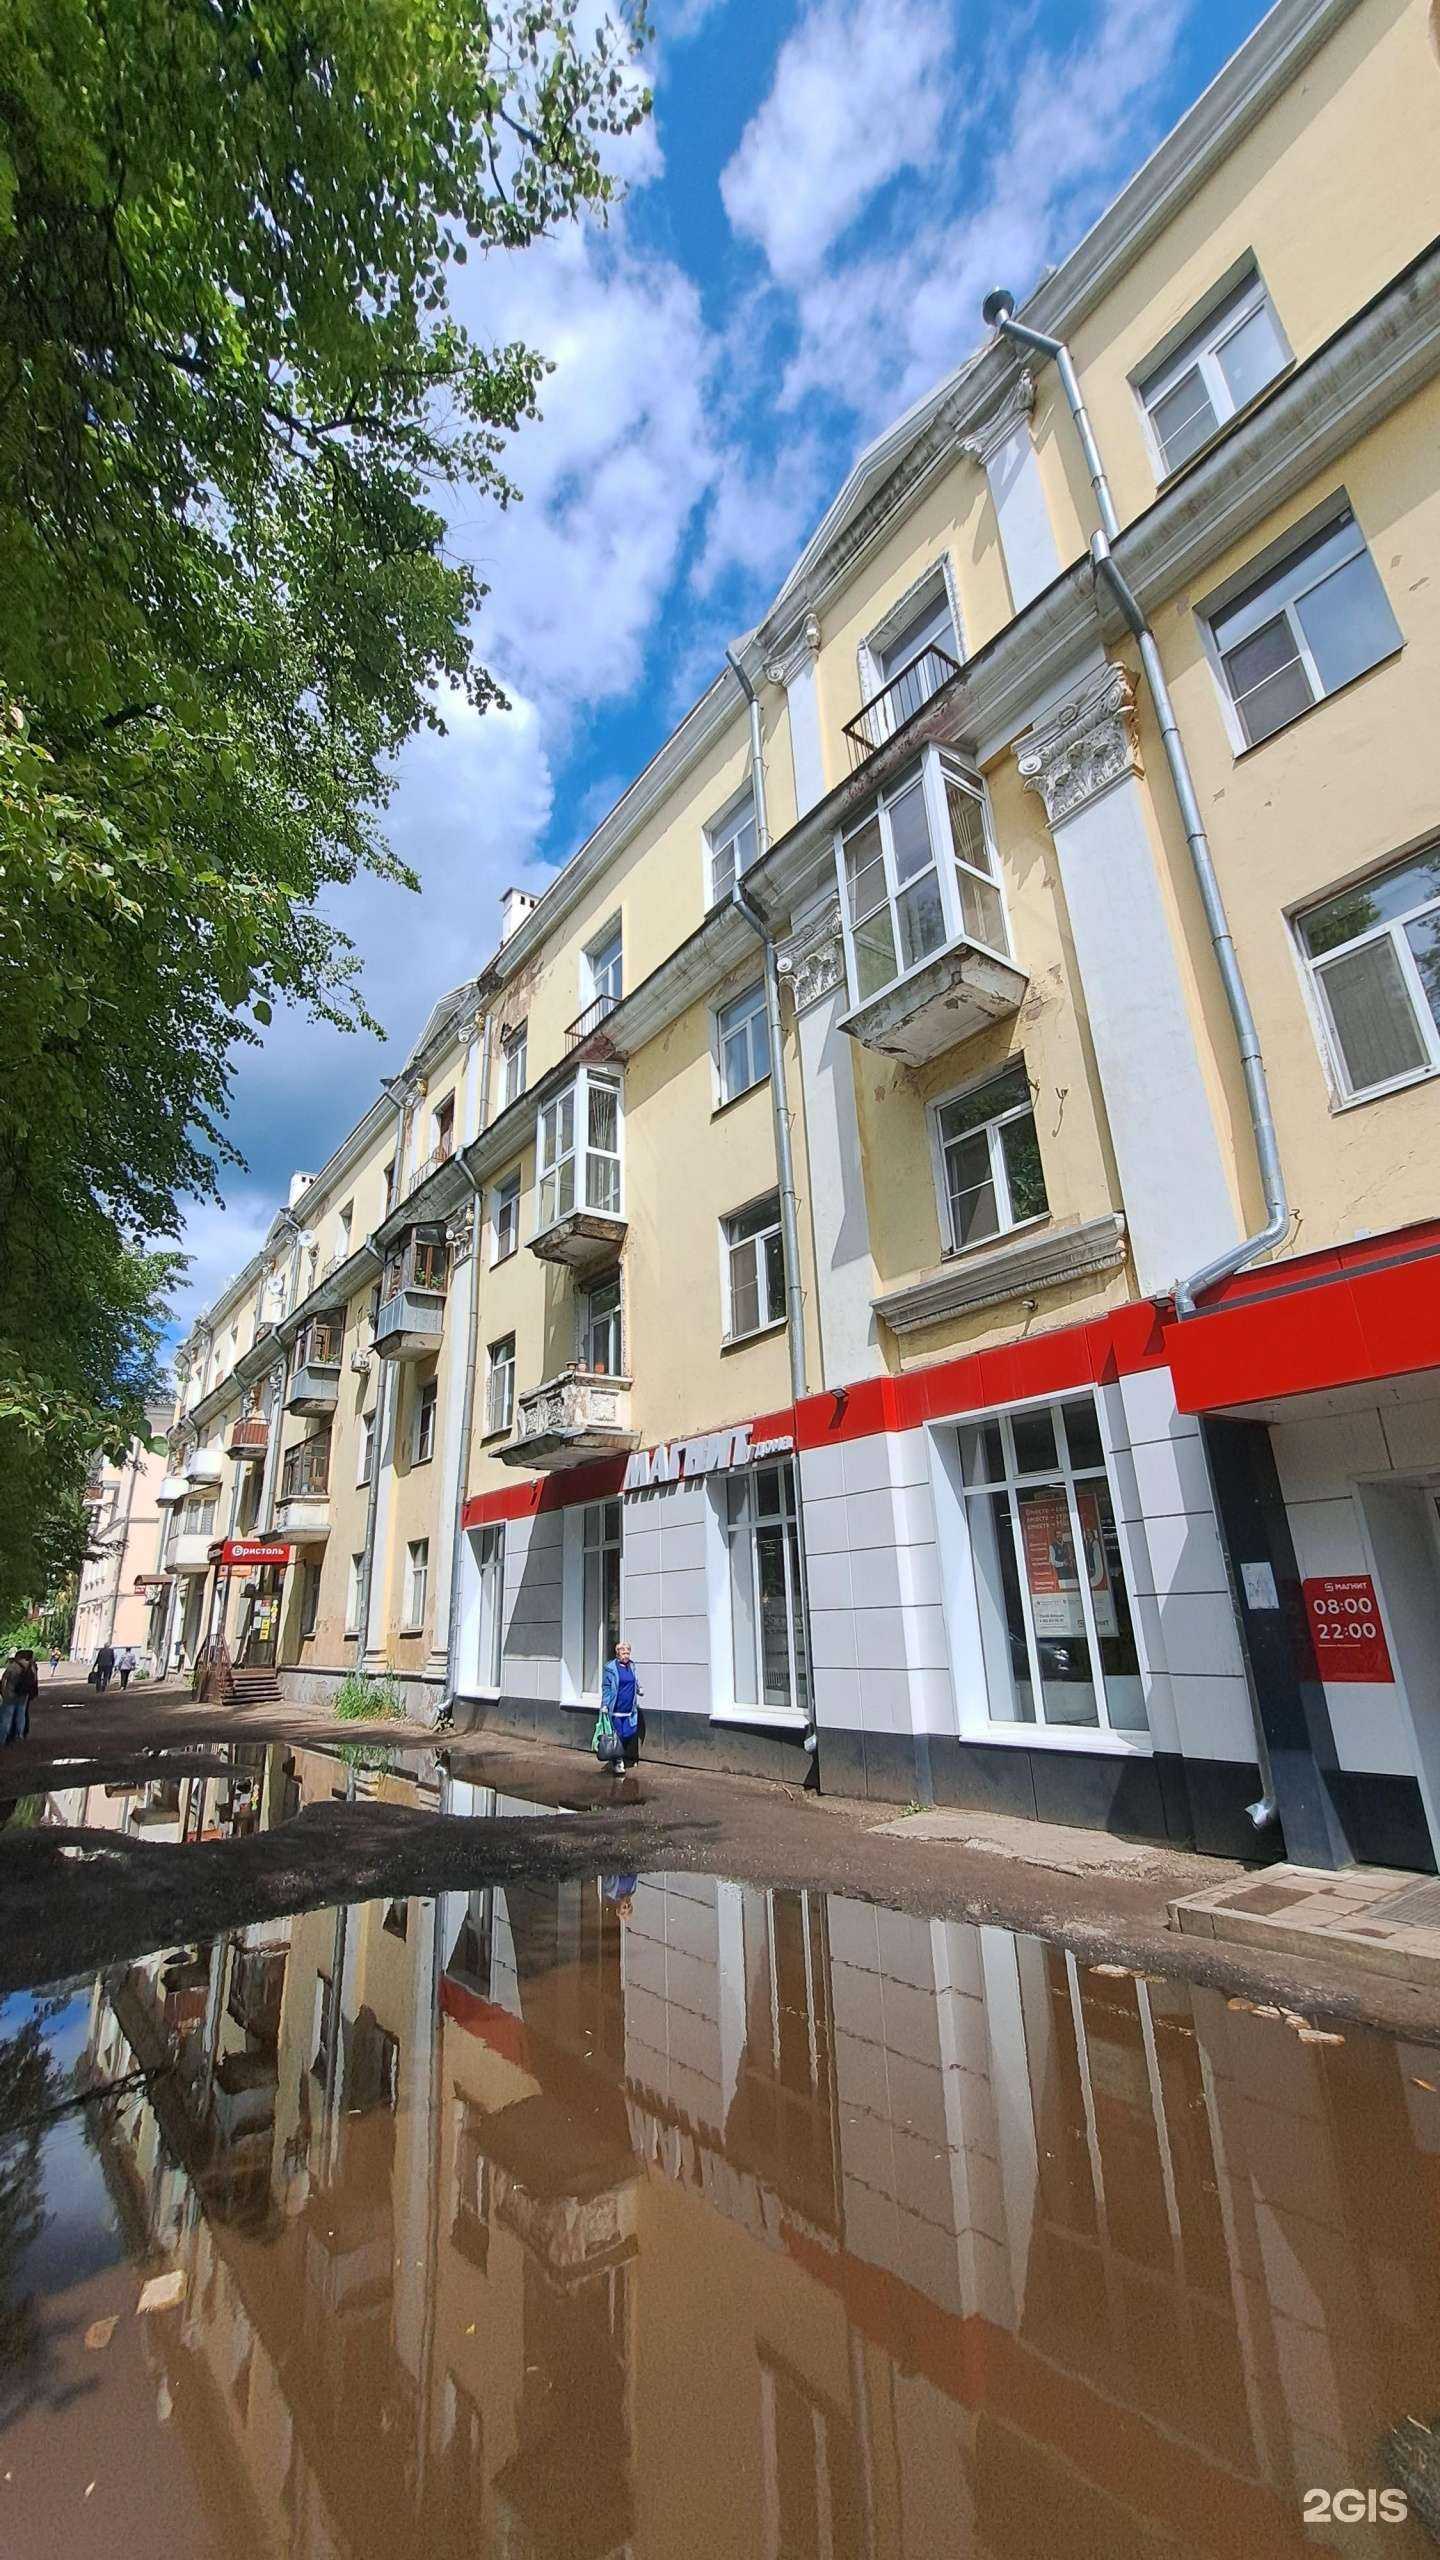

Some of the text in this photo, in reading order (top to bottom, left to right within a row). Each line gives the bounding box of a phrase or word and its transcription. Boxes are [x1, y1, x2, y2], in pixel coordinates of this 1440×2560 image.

[622, 1424, 753, 1491] МАГНИТ
[231, 1544, 284, 1557] Бристоль
[1334, 1582, 1368, 1590] МАГНИТ
[1313, 1597, 1372, 1615] 08:00
[1317, 1622, 1377, 1639] 22:00
